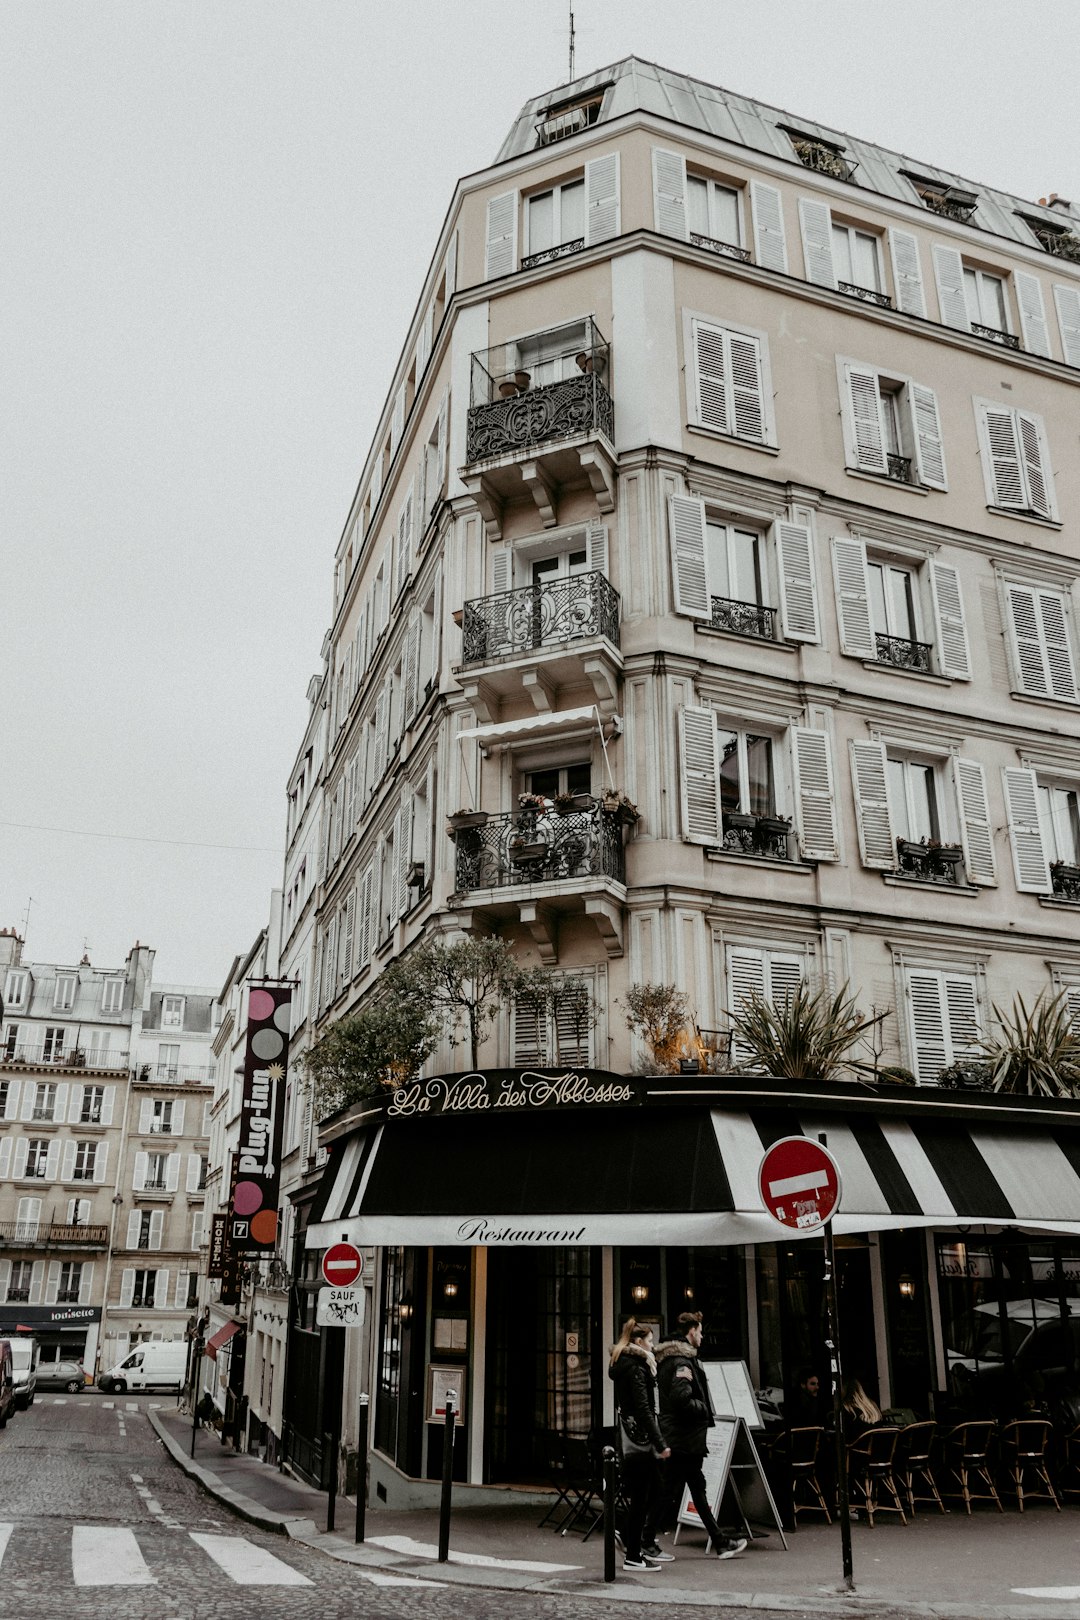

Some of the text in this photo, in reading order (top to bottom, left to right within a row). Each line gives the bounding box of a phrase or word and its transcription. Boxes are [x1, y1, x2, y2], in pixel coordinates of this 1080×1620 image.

[387, 1071, 635, 1116] La Villa des Abbesses
[239, 1068, 272, 1175] Plug-inn
[212, 1220, 225, 1262] HOTEL
[236, 1223, 246, 1236] 7
[457, 1217, 587, 1242] Restaurant
[330, 1290, 355, 1301] SAUF
